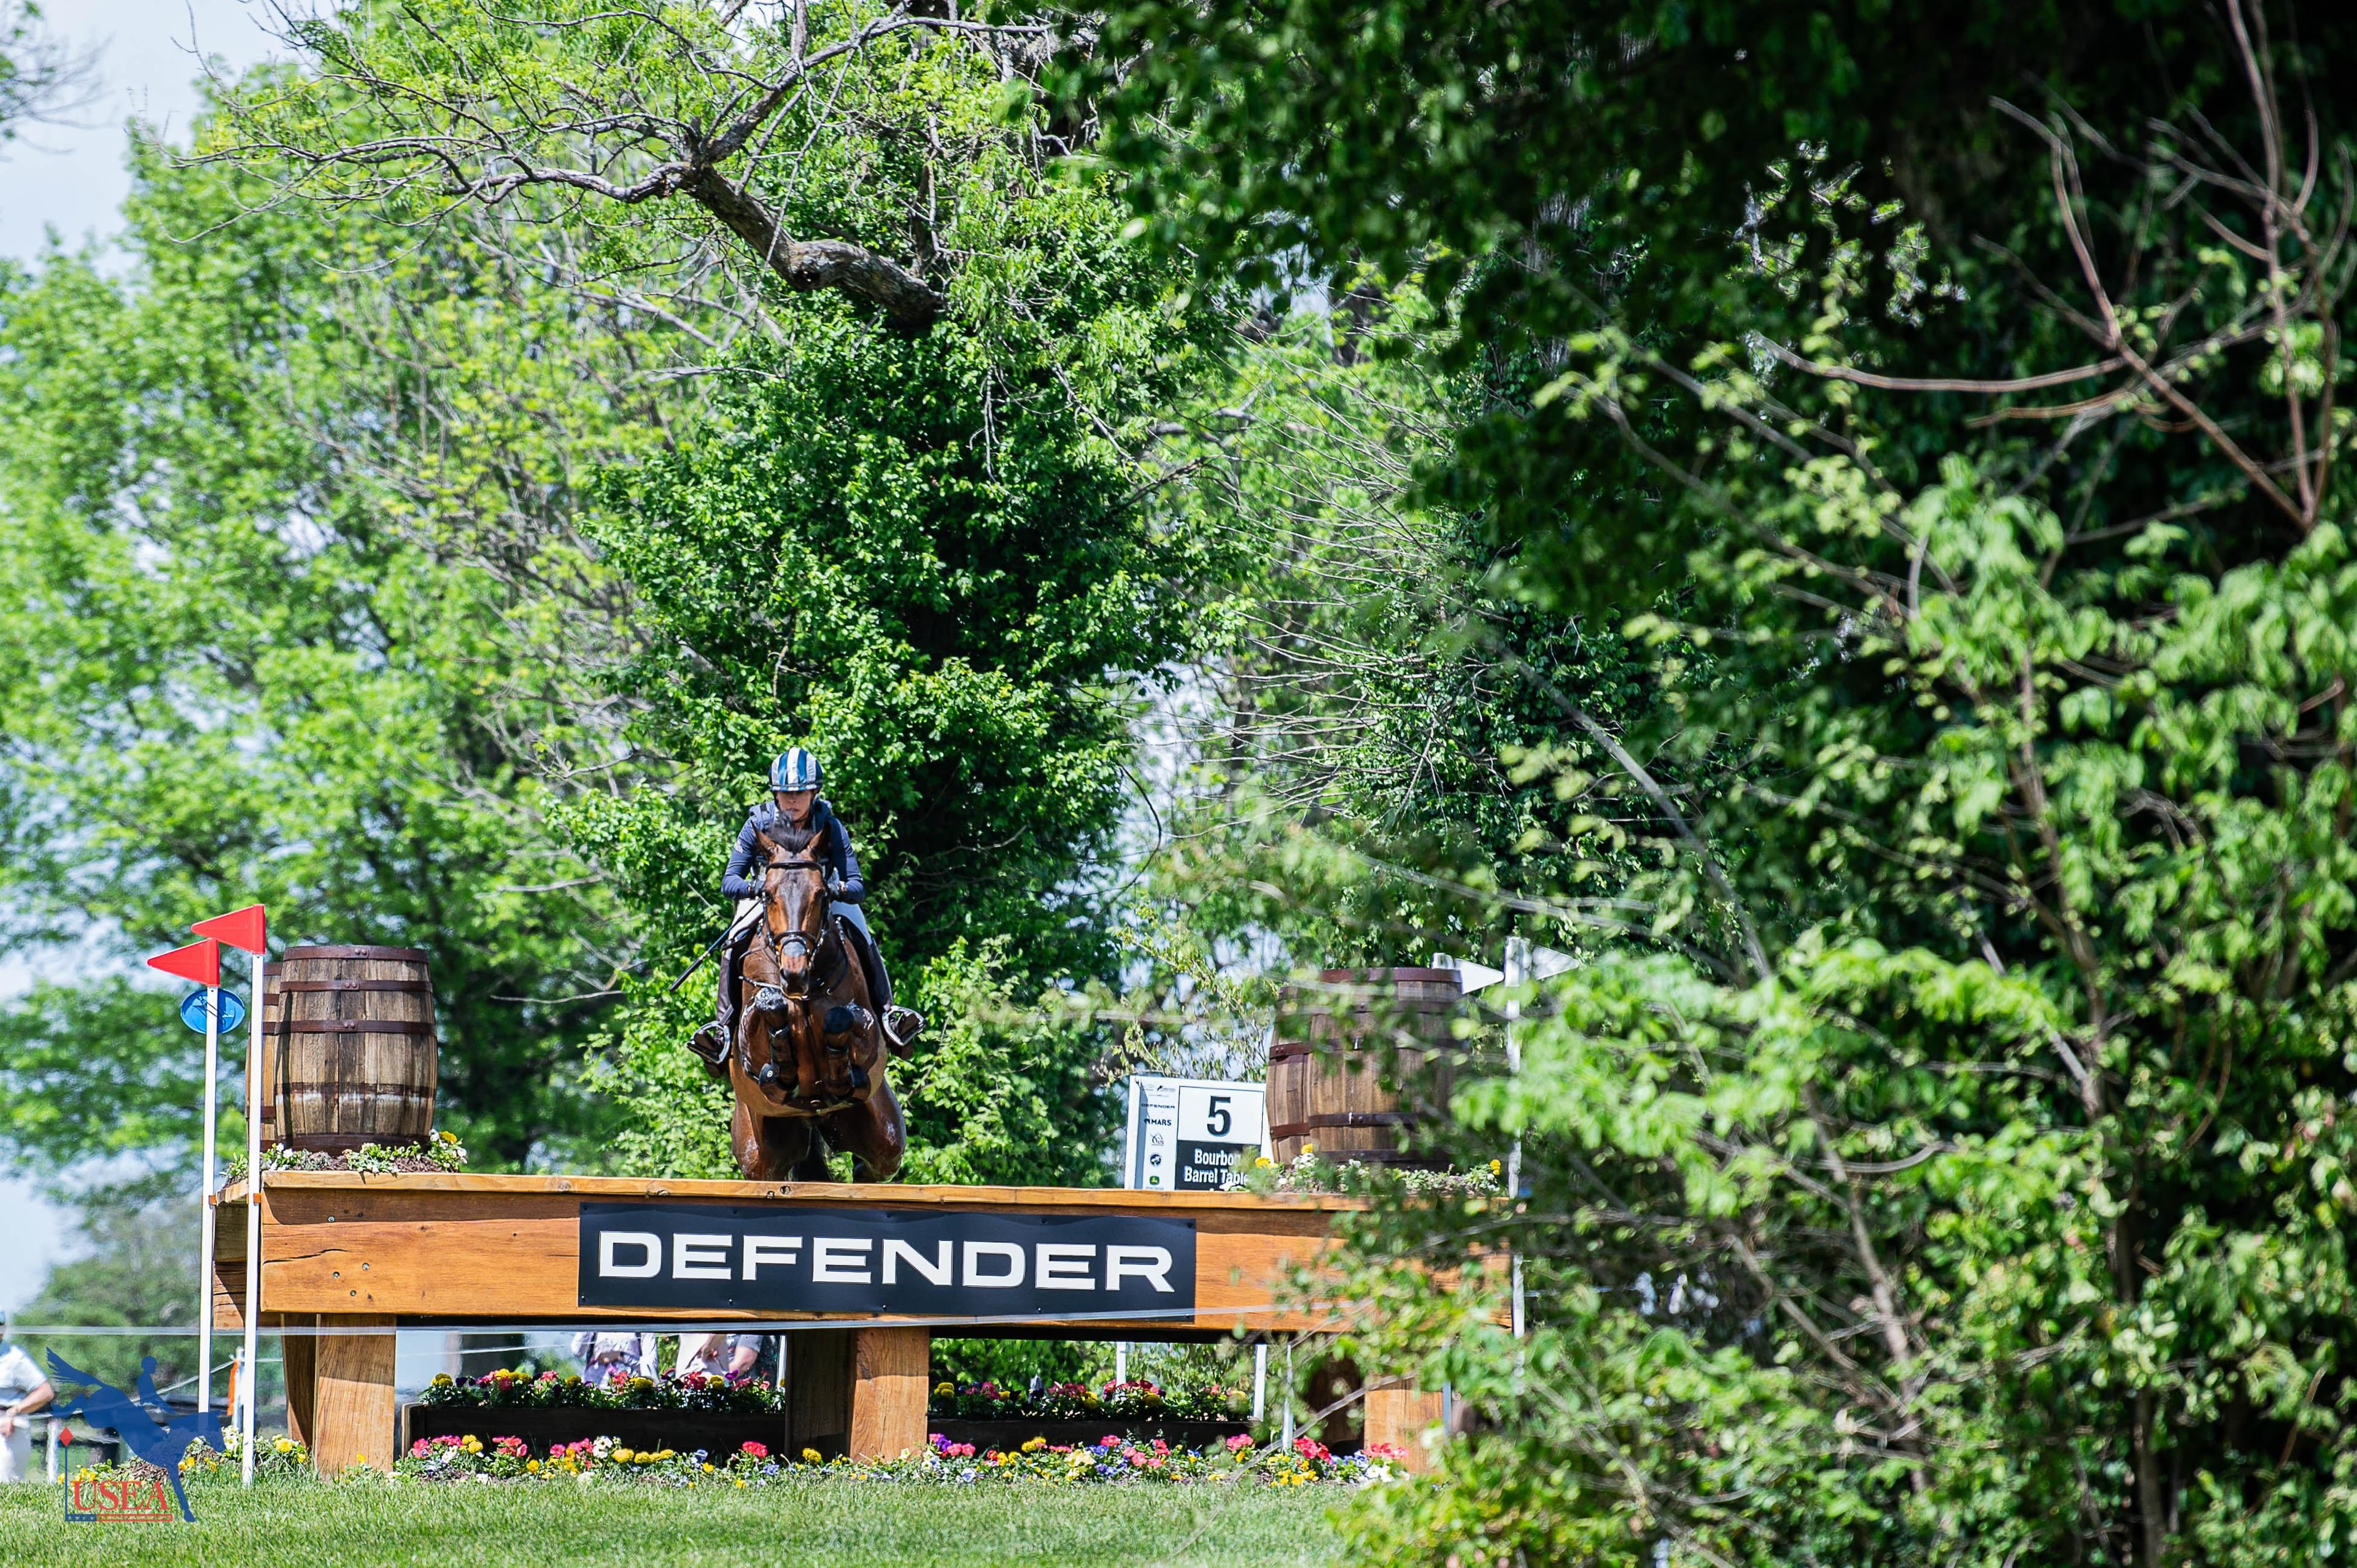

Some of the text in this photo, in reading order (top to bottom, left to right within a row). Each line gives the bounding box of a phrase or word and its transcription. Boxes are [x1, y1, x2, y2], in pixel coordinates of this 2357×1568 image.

[1207, 1095, 1231, 1137] 5
[1184, 1165, 1218, 1184] Barrel
[598, 1230, 1175, 1293] DEFENDER
